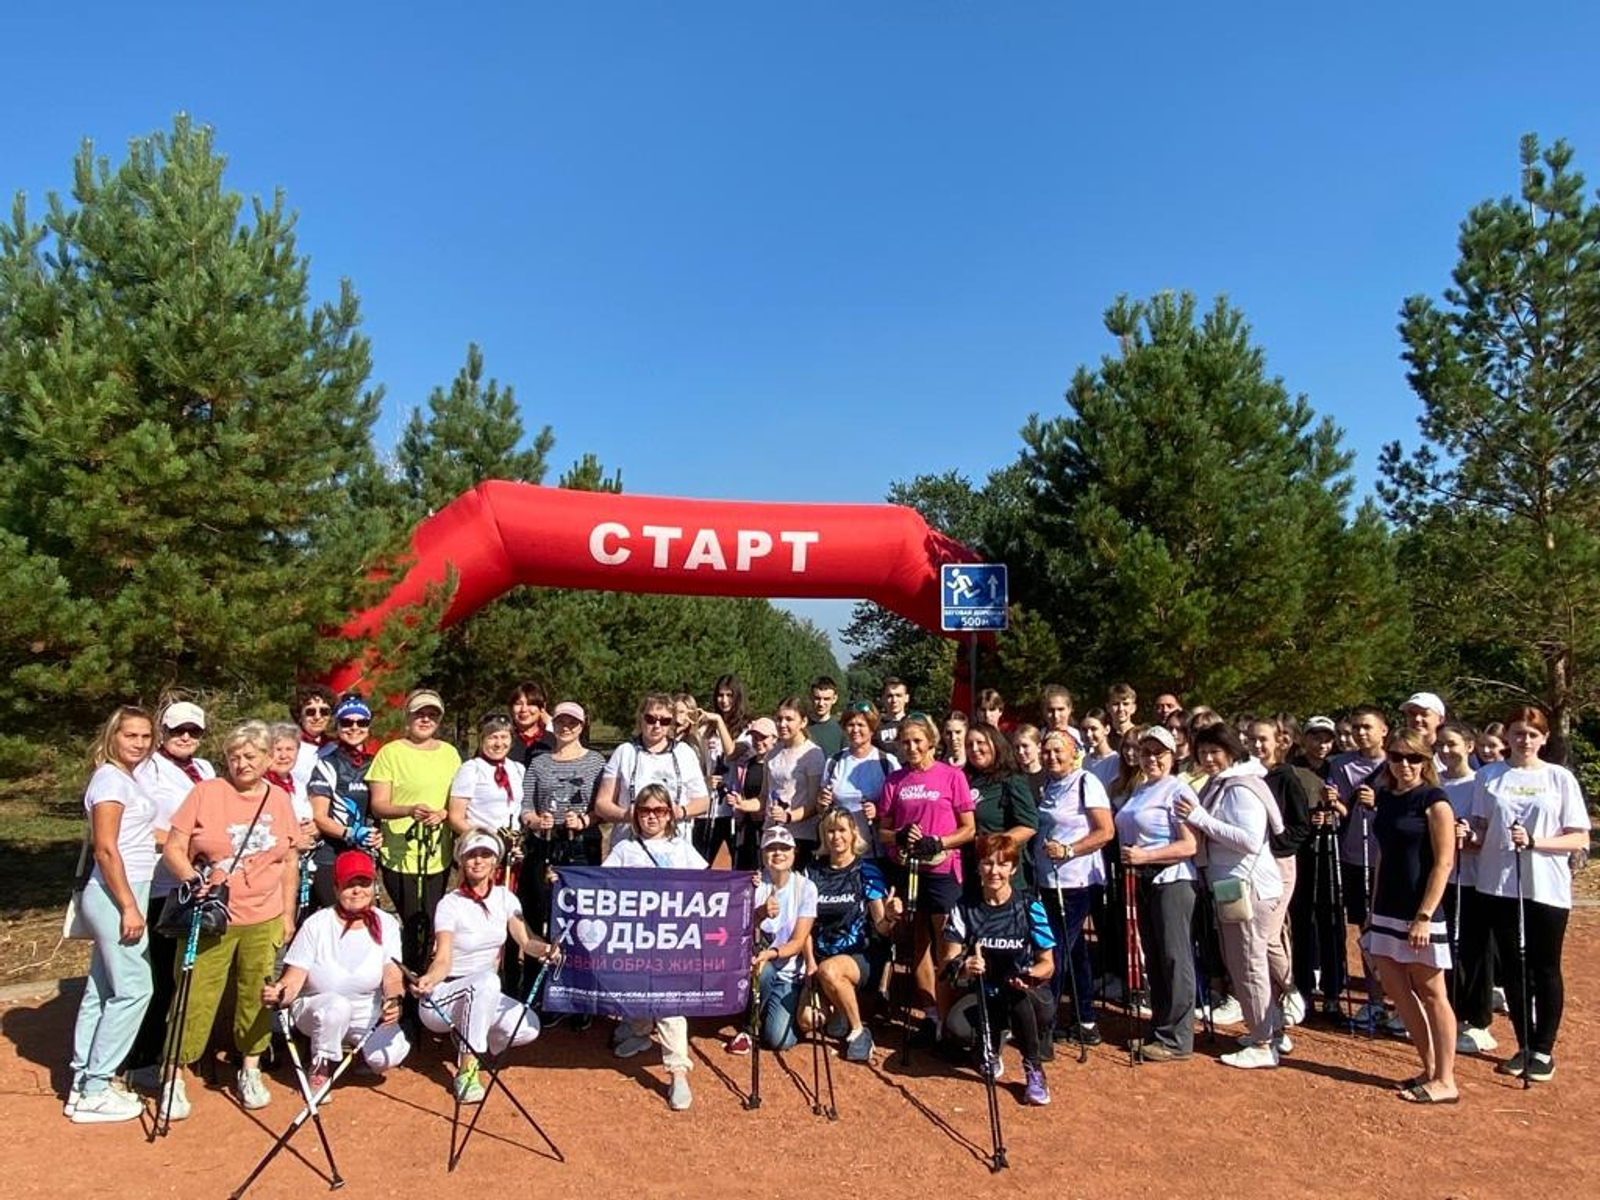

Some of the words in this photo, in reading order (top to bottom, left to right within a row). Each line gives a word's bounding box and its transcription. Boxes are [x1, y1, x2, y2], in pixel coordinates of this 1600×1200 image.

[589, 522, 819, 572] СТАРТ
[881, 728, 898, 741] PU
[557, 888, 730, 917] СЕВЕРНАЯ
[980, 937, 1025, 950] ALIDAK
[565, 954, 607, 971] ОВЫЙ
[612, 957, 663, 972] ОБРАЗ
[668, 957, 726, 972] ЖИЗНИ
